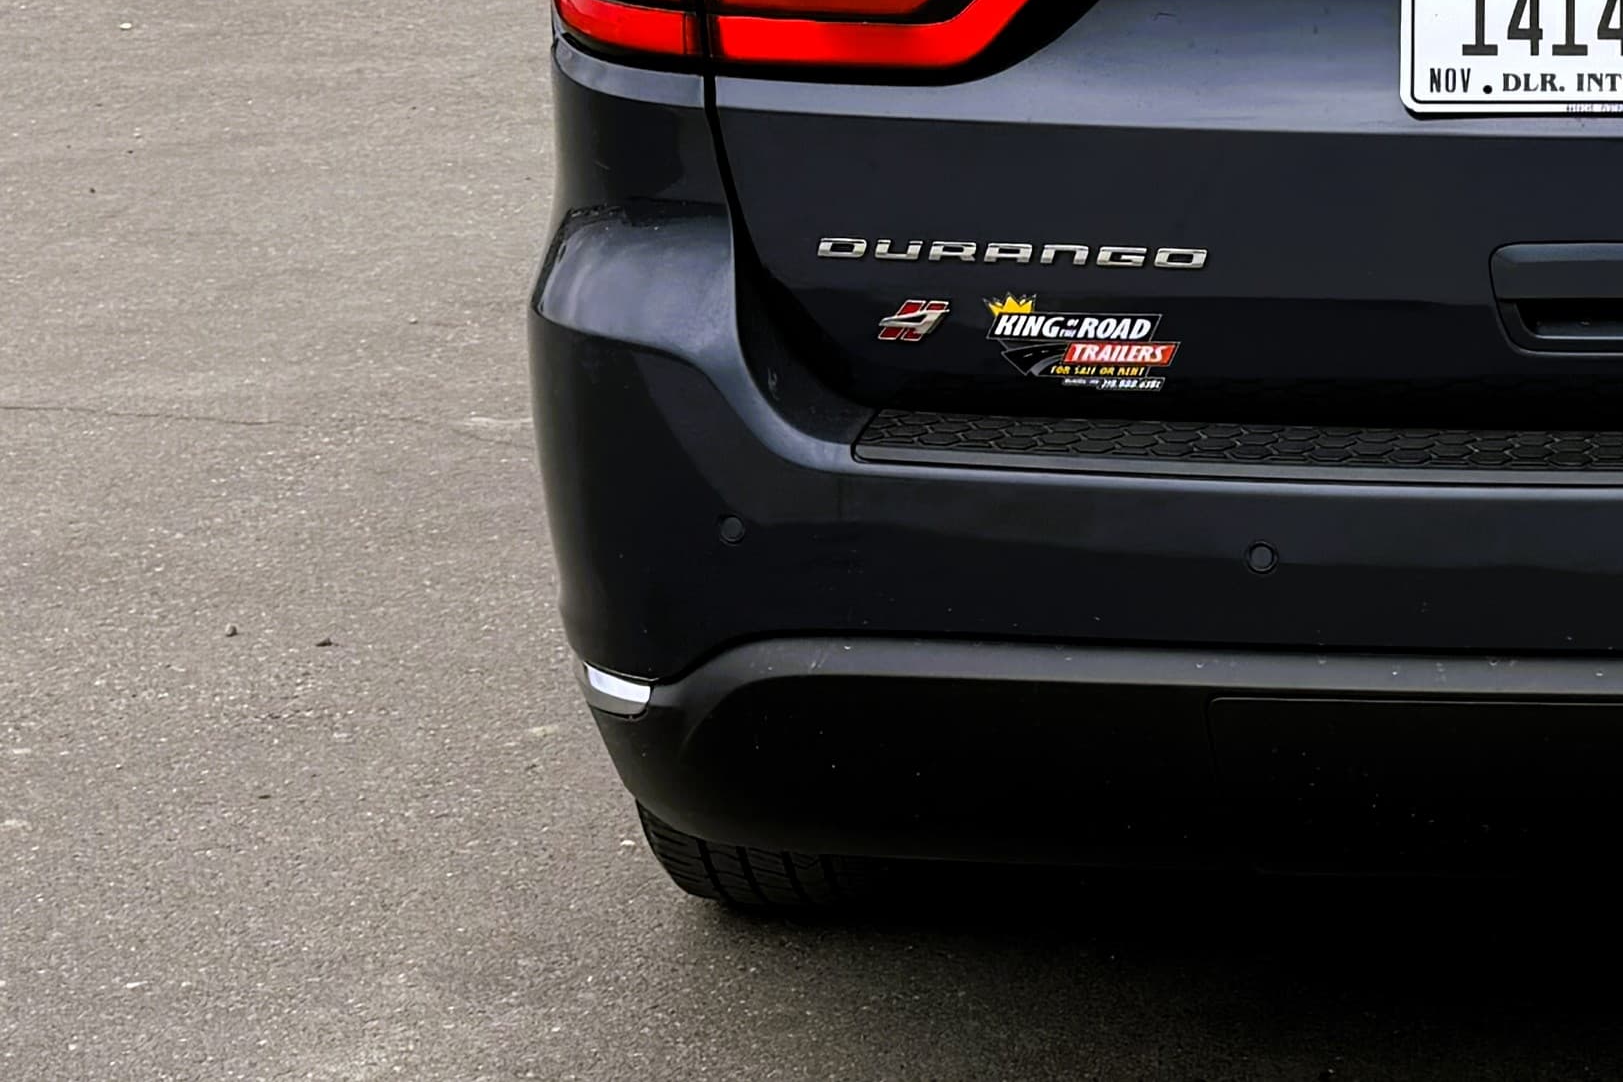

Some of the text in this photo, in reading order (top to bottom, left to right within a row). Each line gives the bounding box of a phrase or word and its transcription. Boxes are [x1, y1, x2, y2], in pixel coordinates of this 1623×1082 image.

[1429, 67, 1472, 94] NOV
[1502, 72, 1566, 94] DLR.
[816, 236, 1209, 269] DURANGO
[994, 315, 1066, 338] KING
[1076, 317, 1152, 340] ROAD
[1071, 344, 1165, 363] TRAILERS
[1050, 365, 1071, 375] FOR
[1100, 366, 1116, 376] OR
